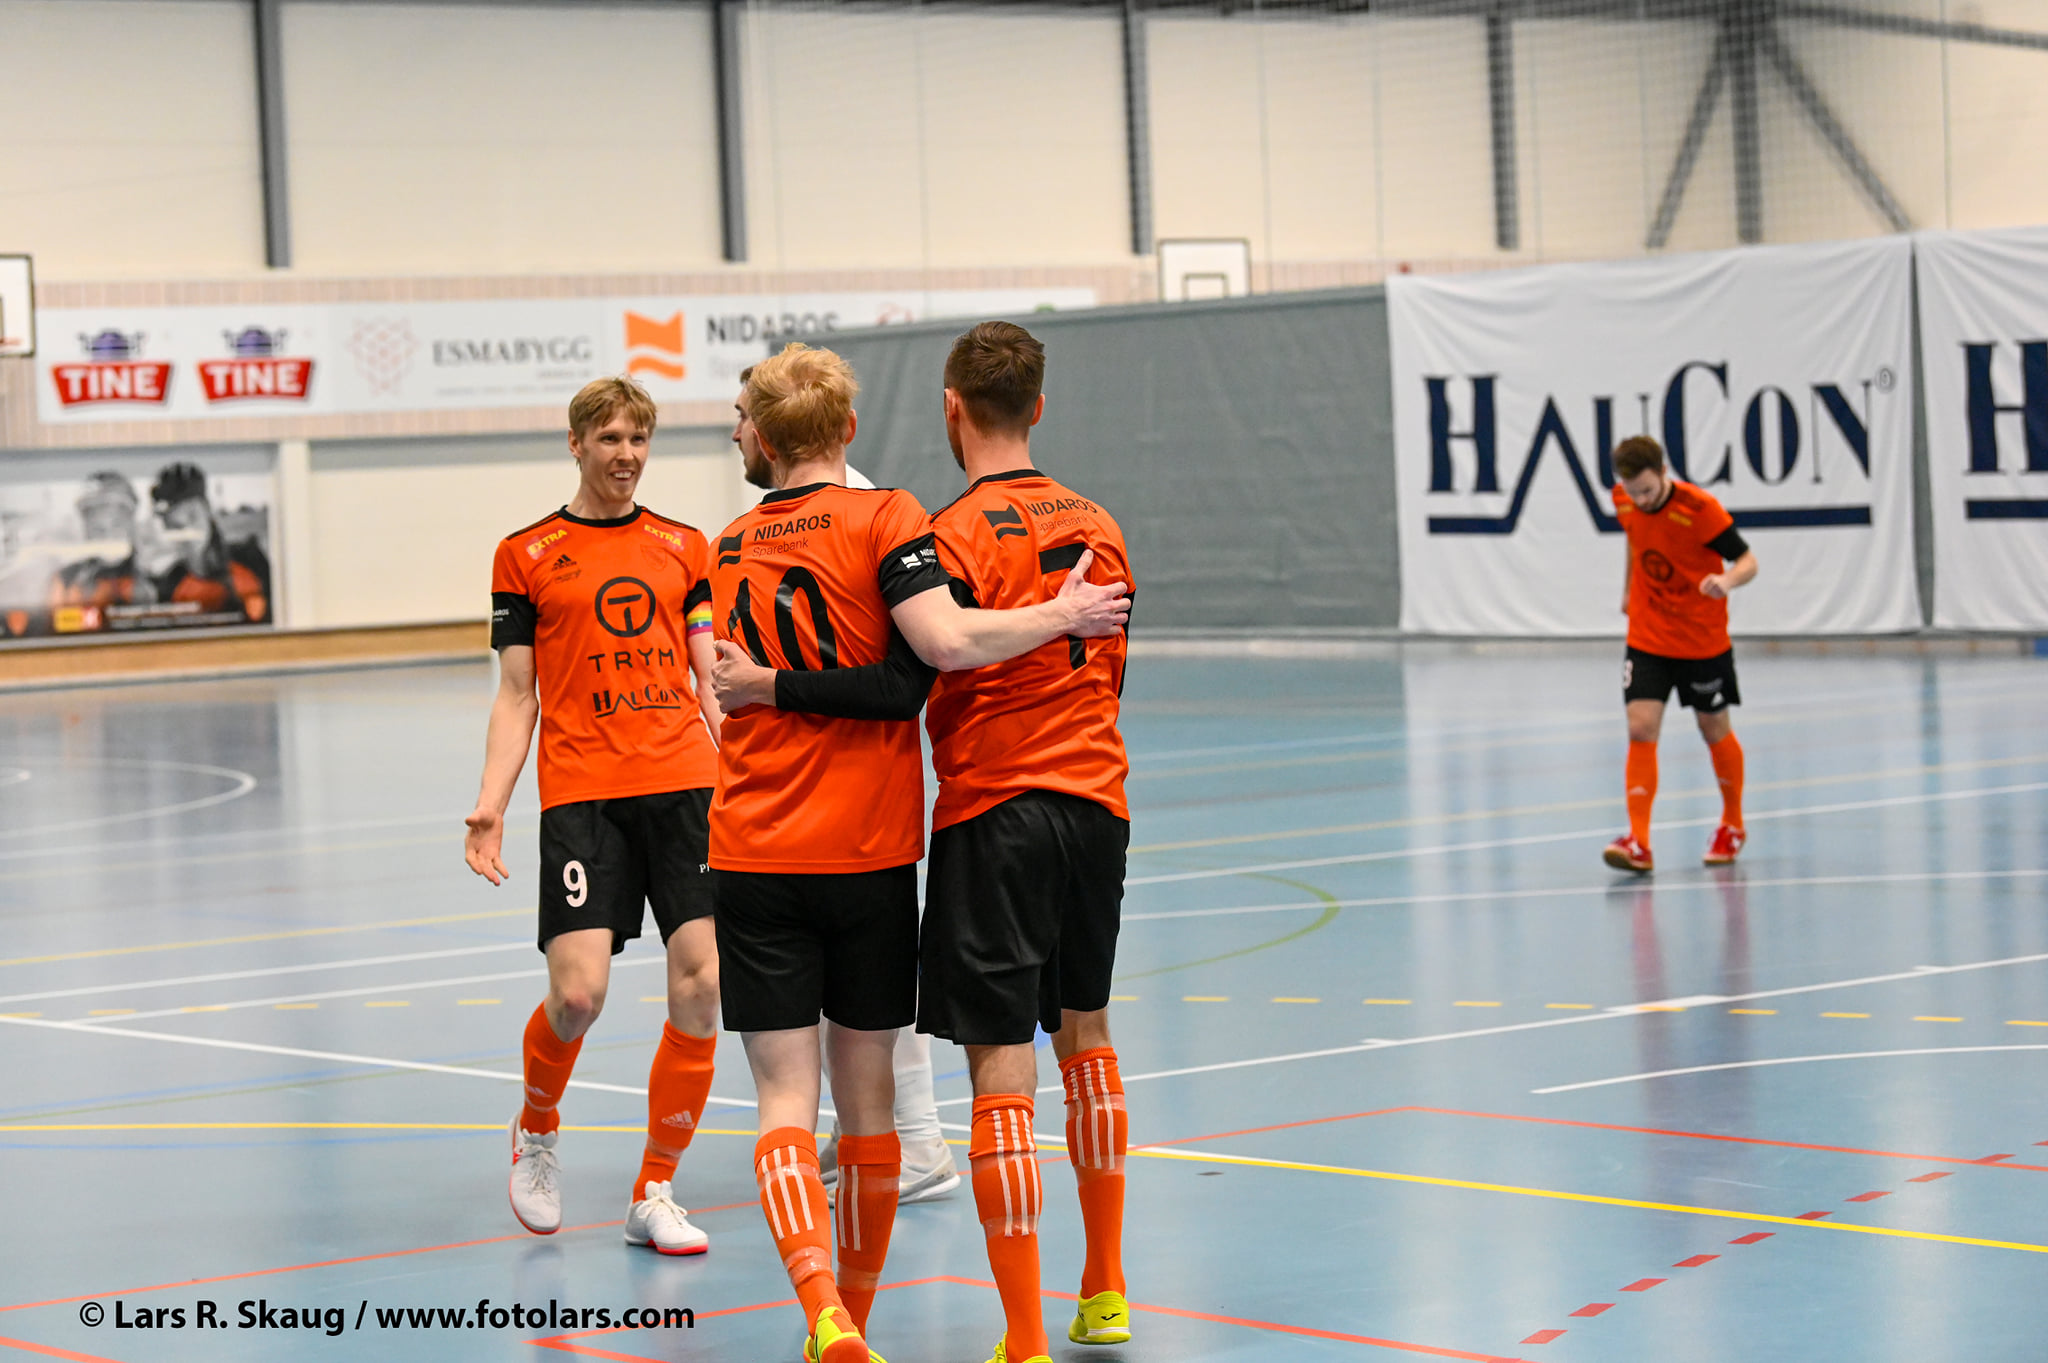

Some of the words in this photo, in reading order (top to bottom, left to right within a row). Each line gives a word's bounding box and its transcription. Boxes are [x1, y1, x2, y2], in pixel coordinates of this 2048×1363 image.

[432, 334, 593, 366] ESMABYGG
[59, 365, 162, 400] TINE
[206, 362, 302, 396] TINE
[1025, 498, 1098, 516] NIDAROS
[528, 529, 568, 555] EXTRA
[644, 524, 681, 547] EXTRA
[753, 513, 832, 542] NIDAROS
[751, 537, 809, 557] Sparebank
[727, 566, 839, 671] 10
[587, 648, 676, 673] TRYM
[562, 859, 588, 908] 9
